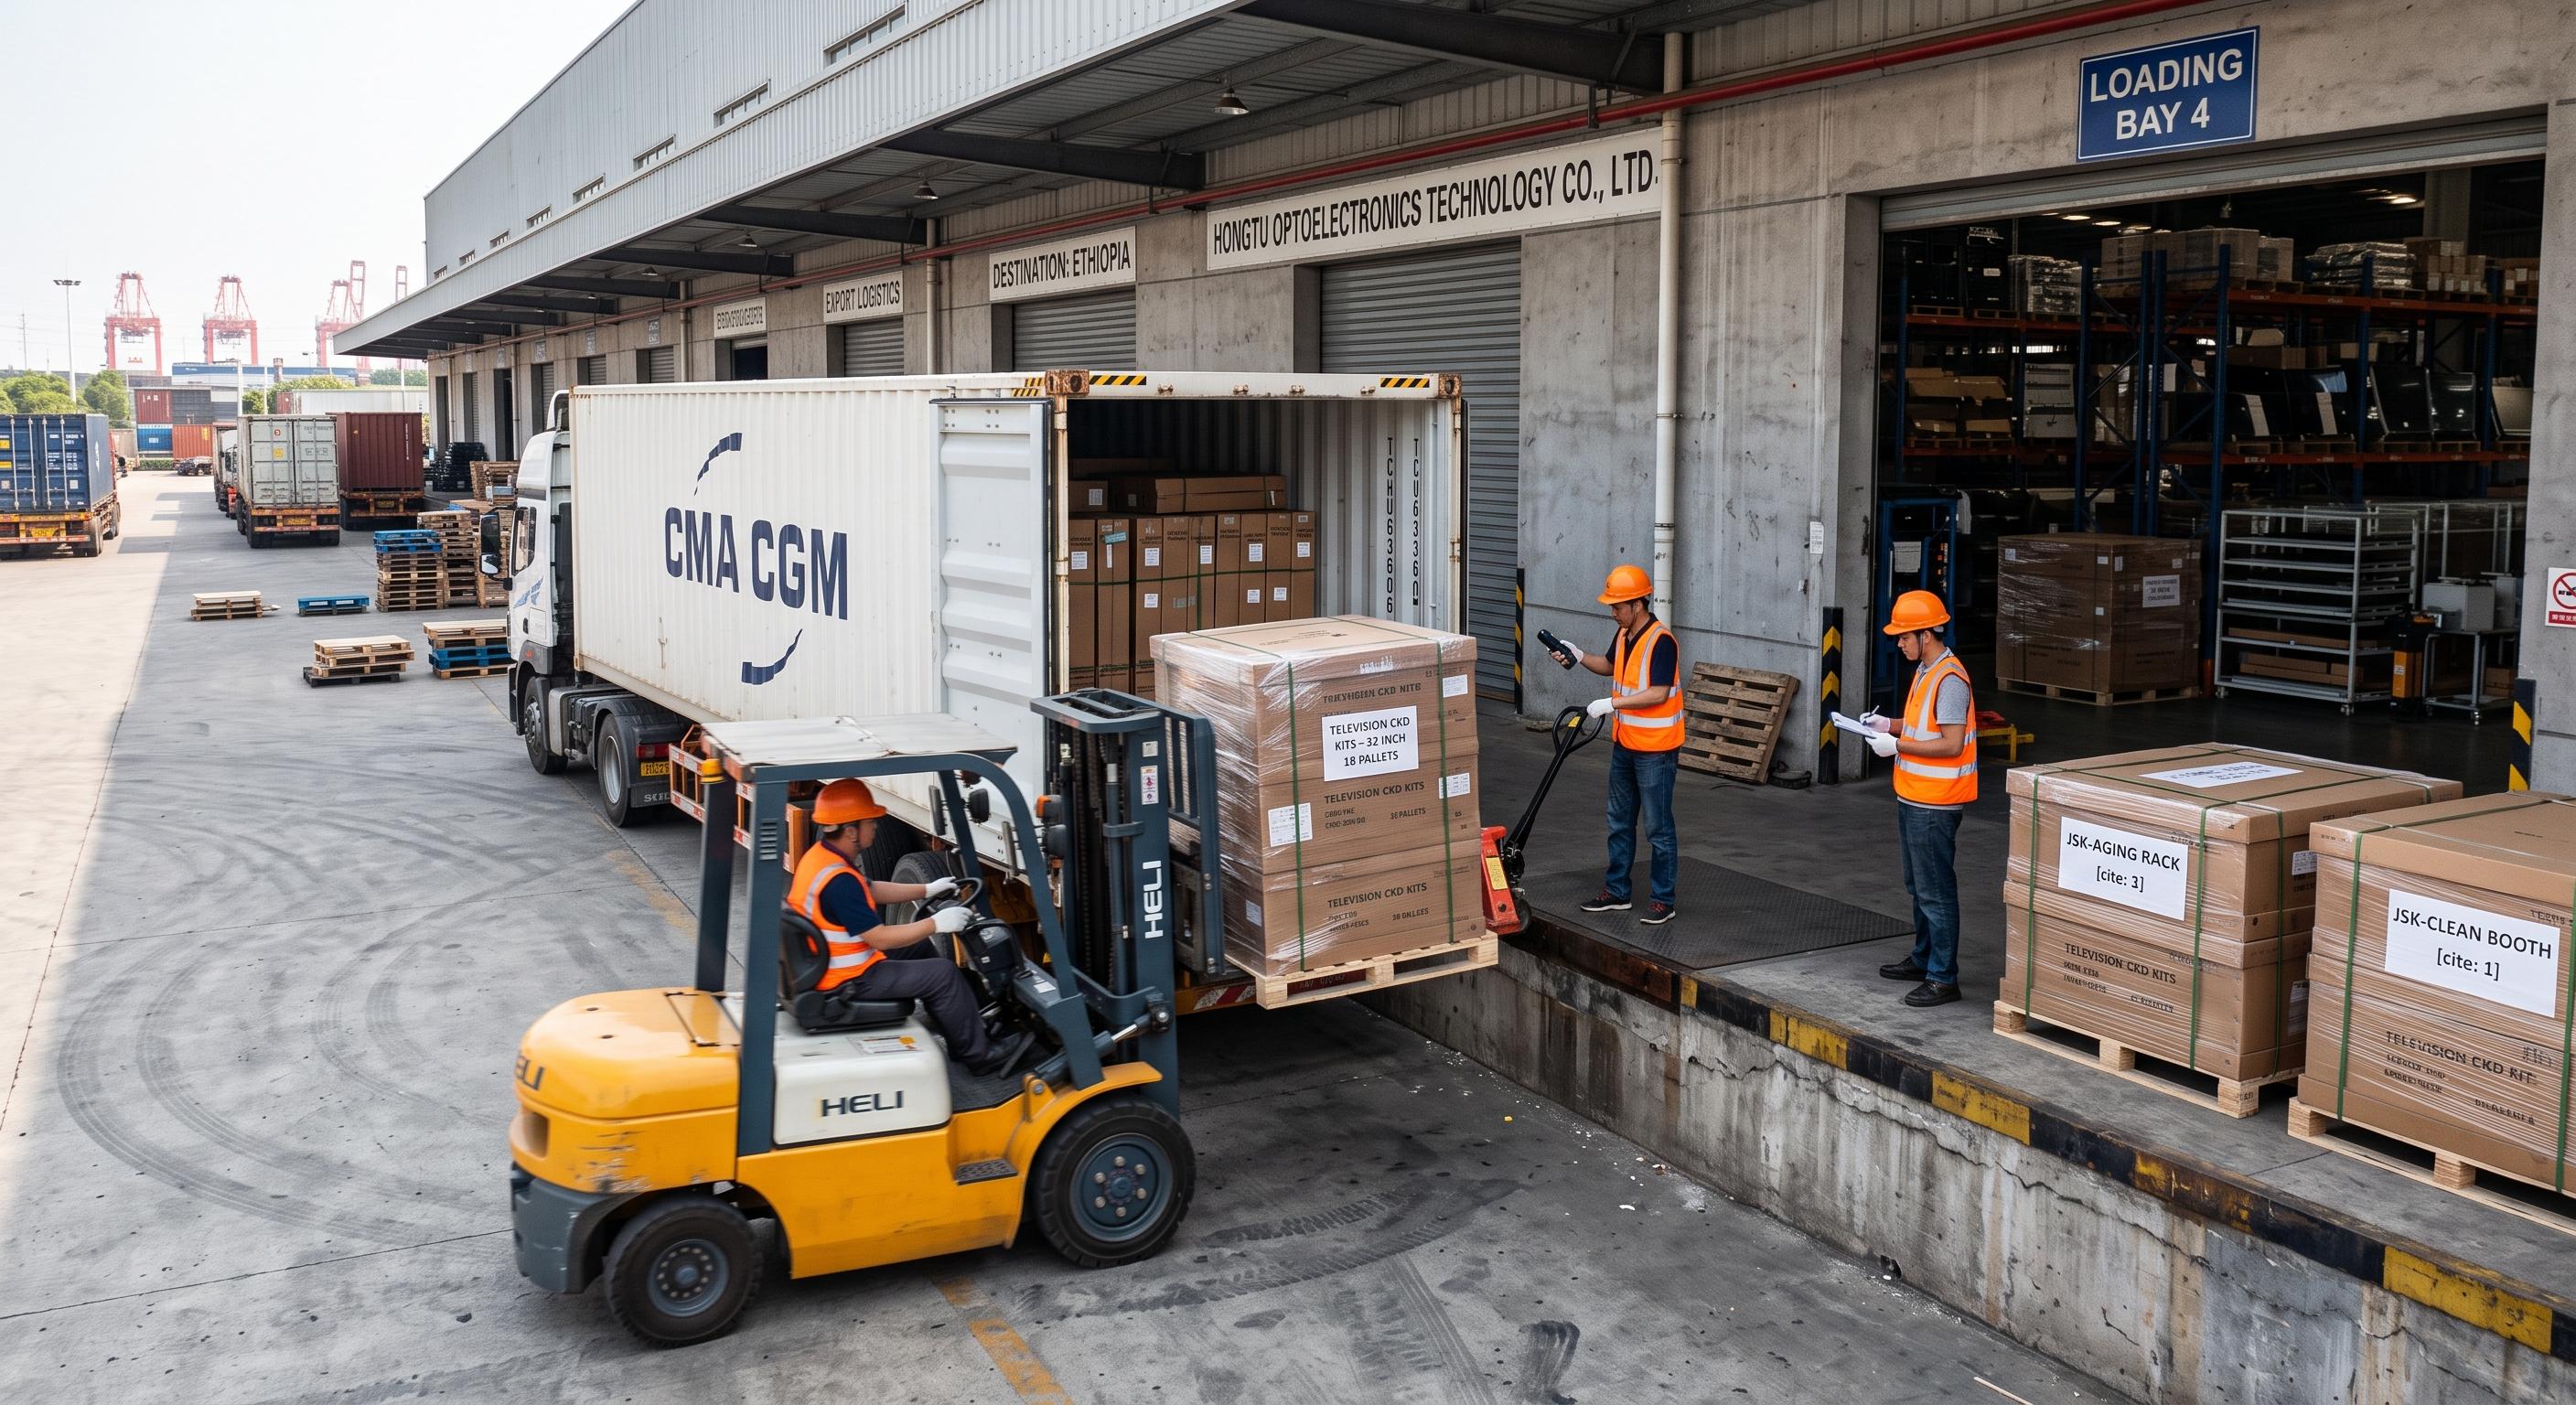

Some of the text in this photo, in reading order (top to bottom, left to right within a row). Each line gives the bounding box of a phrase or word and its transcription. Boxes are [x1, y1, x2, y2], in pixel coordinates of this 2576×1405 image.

[2089, 48, 2244, 103] LOADING
[2116, 97, 2211, 142] BAY 4
[1213, 149, 1659, 254] HONGTU OPTOELECTRONICS TECHNOLOGY CO., LTD.
[993, 239, 1132, 290] DESTINATION: ETHIOPIA
[825, 280, 901, 314] EXPORT LOGISTICS
[664, 506, 849, 621] CMA CGM
[1329, 716, 1411, 735] TELEVISION CKD
[1335, 739, 1357, 752] KITS
[1367, 737, 1379, 748] 32
[1381, 733, 1406, 745] INCH
[1344, 750, 1399, 767] 18 PALLETS
[1324, 781, 1425, 805] TELEVISION CKD KITS
[1399, 807, 1426, 819] PALLETS
[2066, 832, 2181, 872] JSK-AGING RACK
[2096, 865, 2128, 887] [cite:
[1143, 860, 1164, 939] HELI
[1327, 882, 1428, 908] TELEVISION CKD KITS
[2393, 907, 2552, 960] JSK-CLEAN BOOTH
[2065, 943, 2123, 969] TELEVISION
[2127, 961, 2149, 976] CKD
[2437, 948, 2500, 981] [cite: 1]
[2472, 1056, 2504, 1075] CKD
[821, 1089, 905, 1117] HELI
